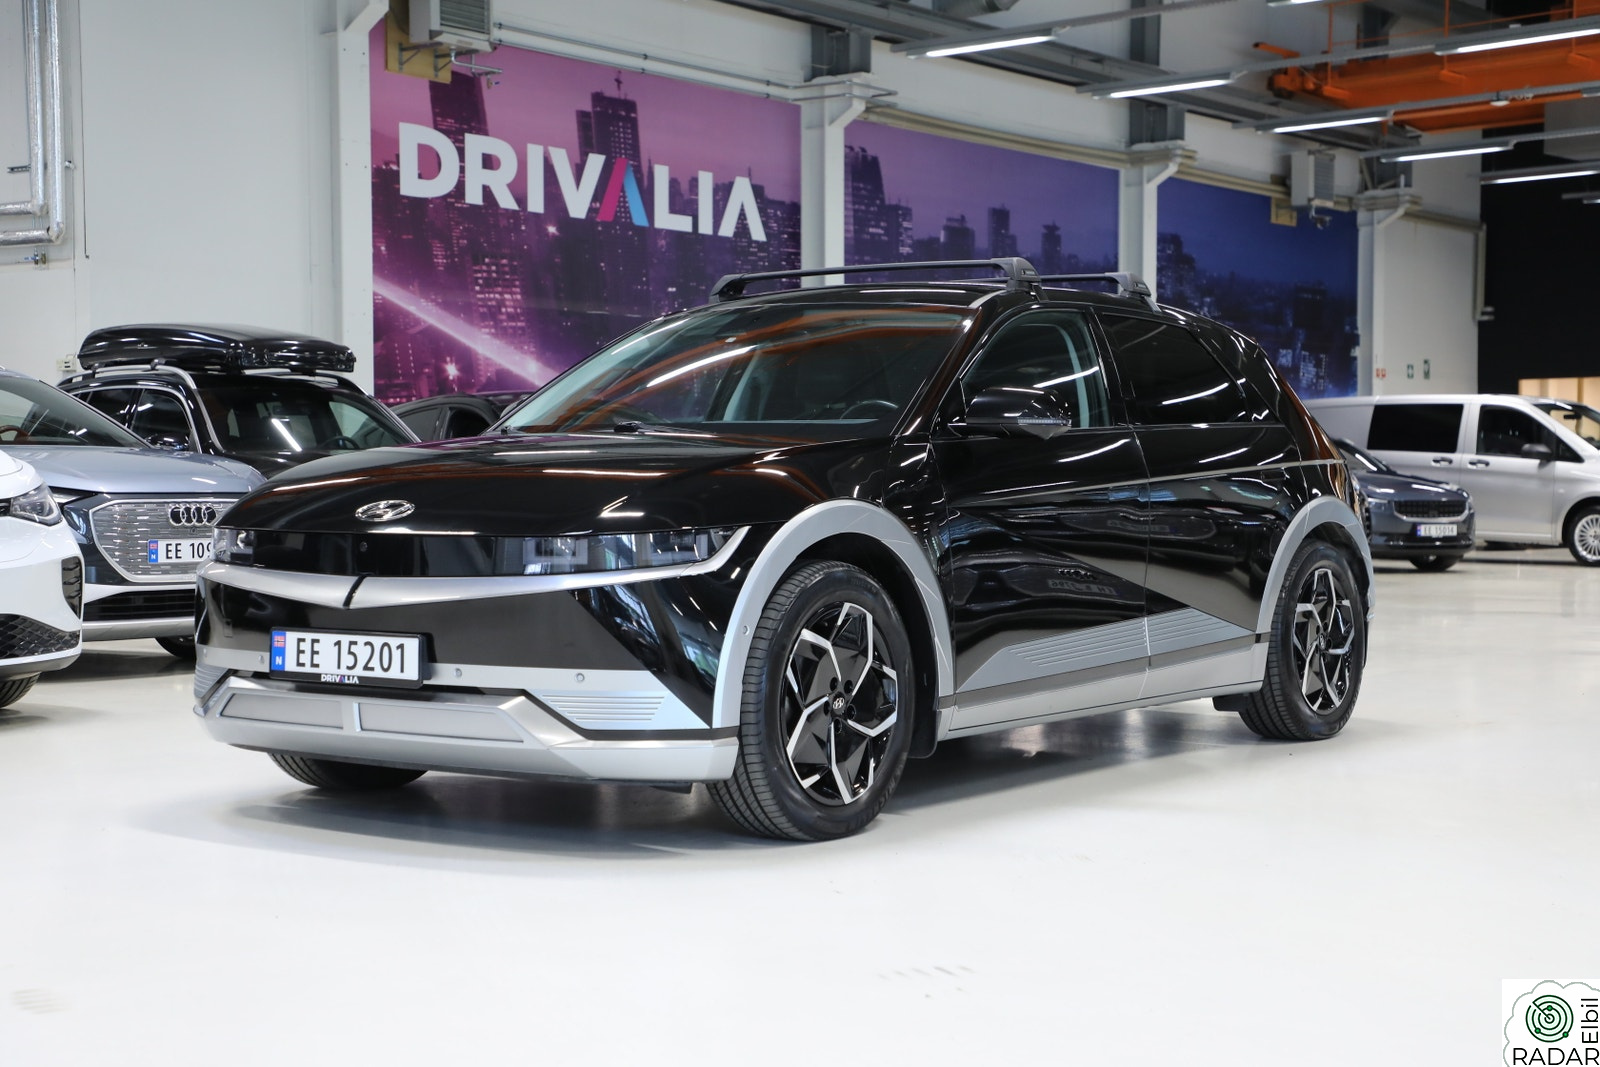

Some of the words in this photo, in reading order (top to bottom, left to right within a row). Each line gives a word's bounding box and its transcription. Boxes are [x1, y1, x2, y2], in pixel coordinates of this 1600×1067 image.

[399, 122, 767, 241] DRIVALIA
[165, 543, 182, 559] EE
[275, 655, 283, 665] N
[296, 637, 320, 668] EE
[333, 639, 405, 673] 15201
[320, 674, 359, 684] DRIVALIA
